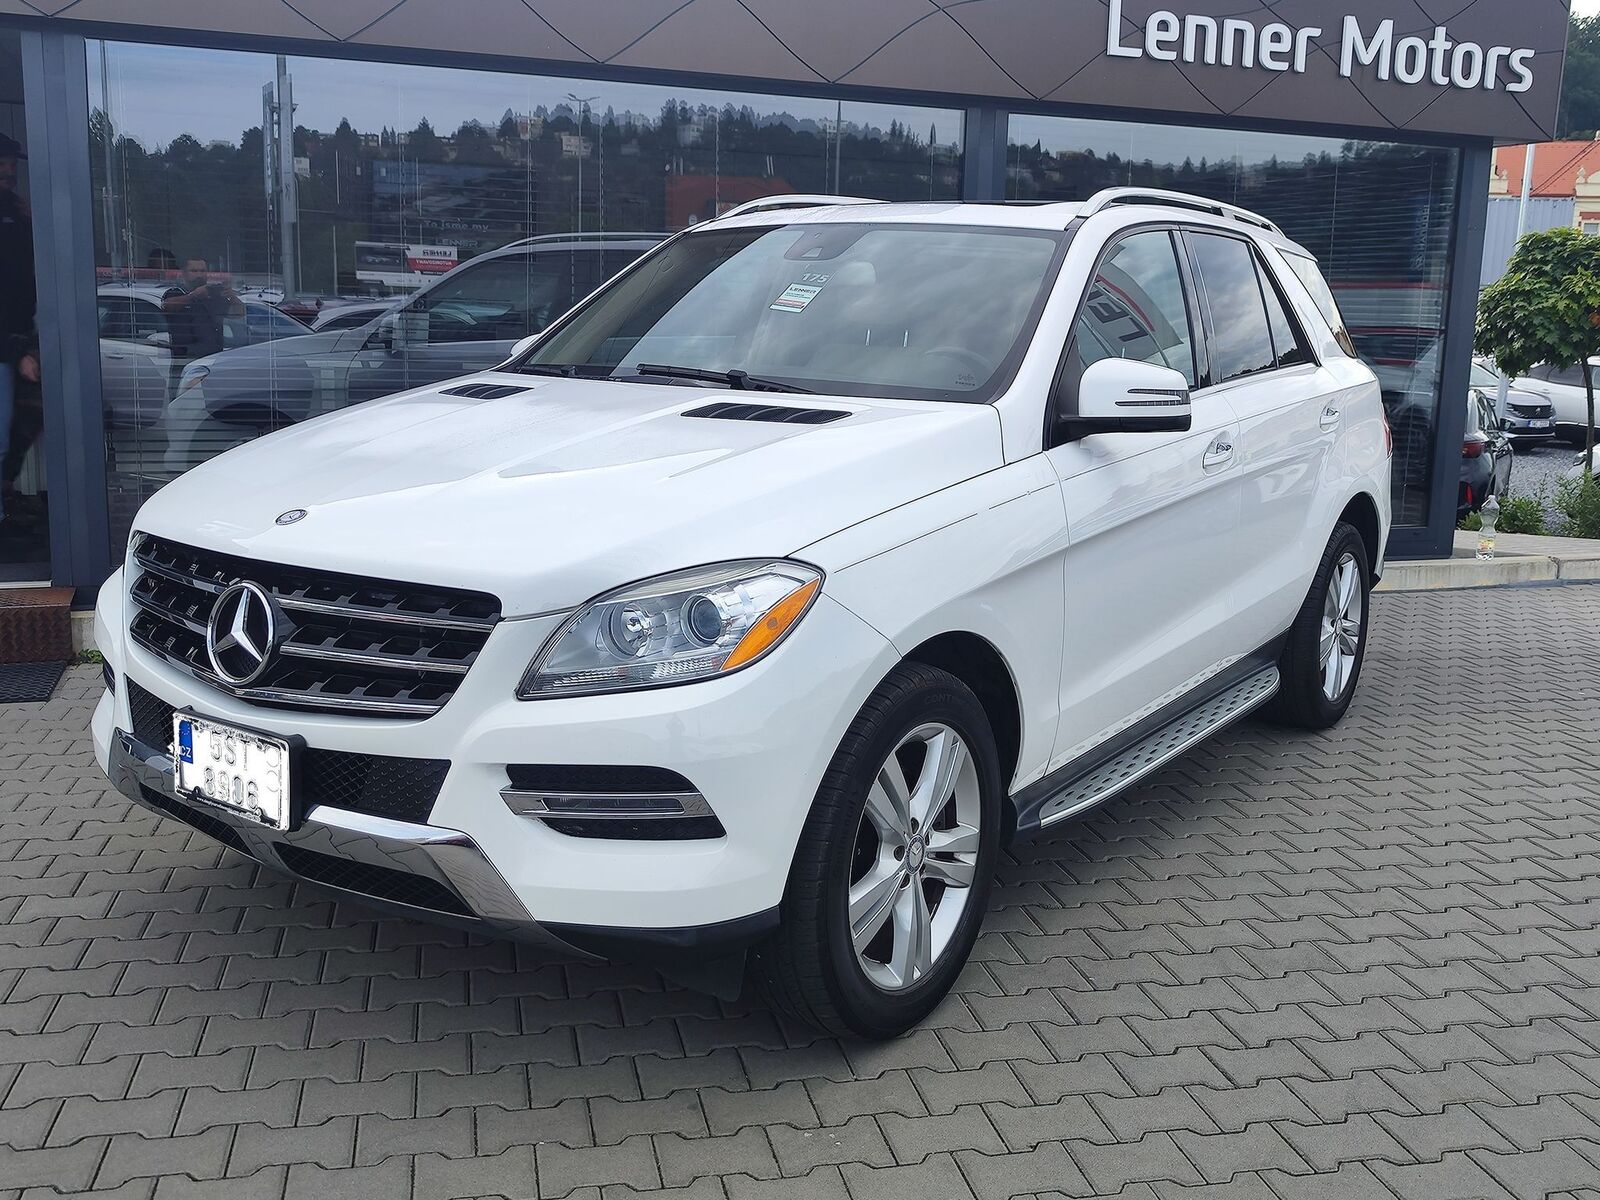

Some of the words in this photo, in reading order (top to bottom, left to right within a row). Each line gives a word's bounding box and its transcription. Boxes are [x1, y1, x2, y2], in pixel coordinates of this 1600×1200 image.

[1107, 0, 1322, 73] Lenner
[1340, 15, 1535, 92] Motors
[802, 273, 830, 283] 175
